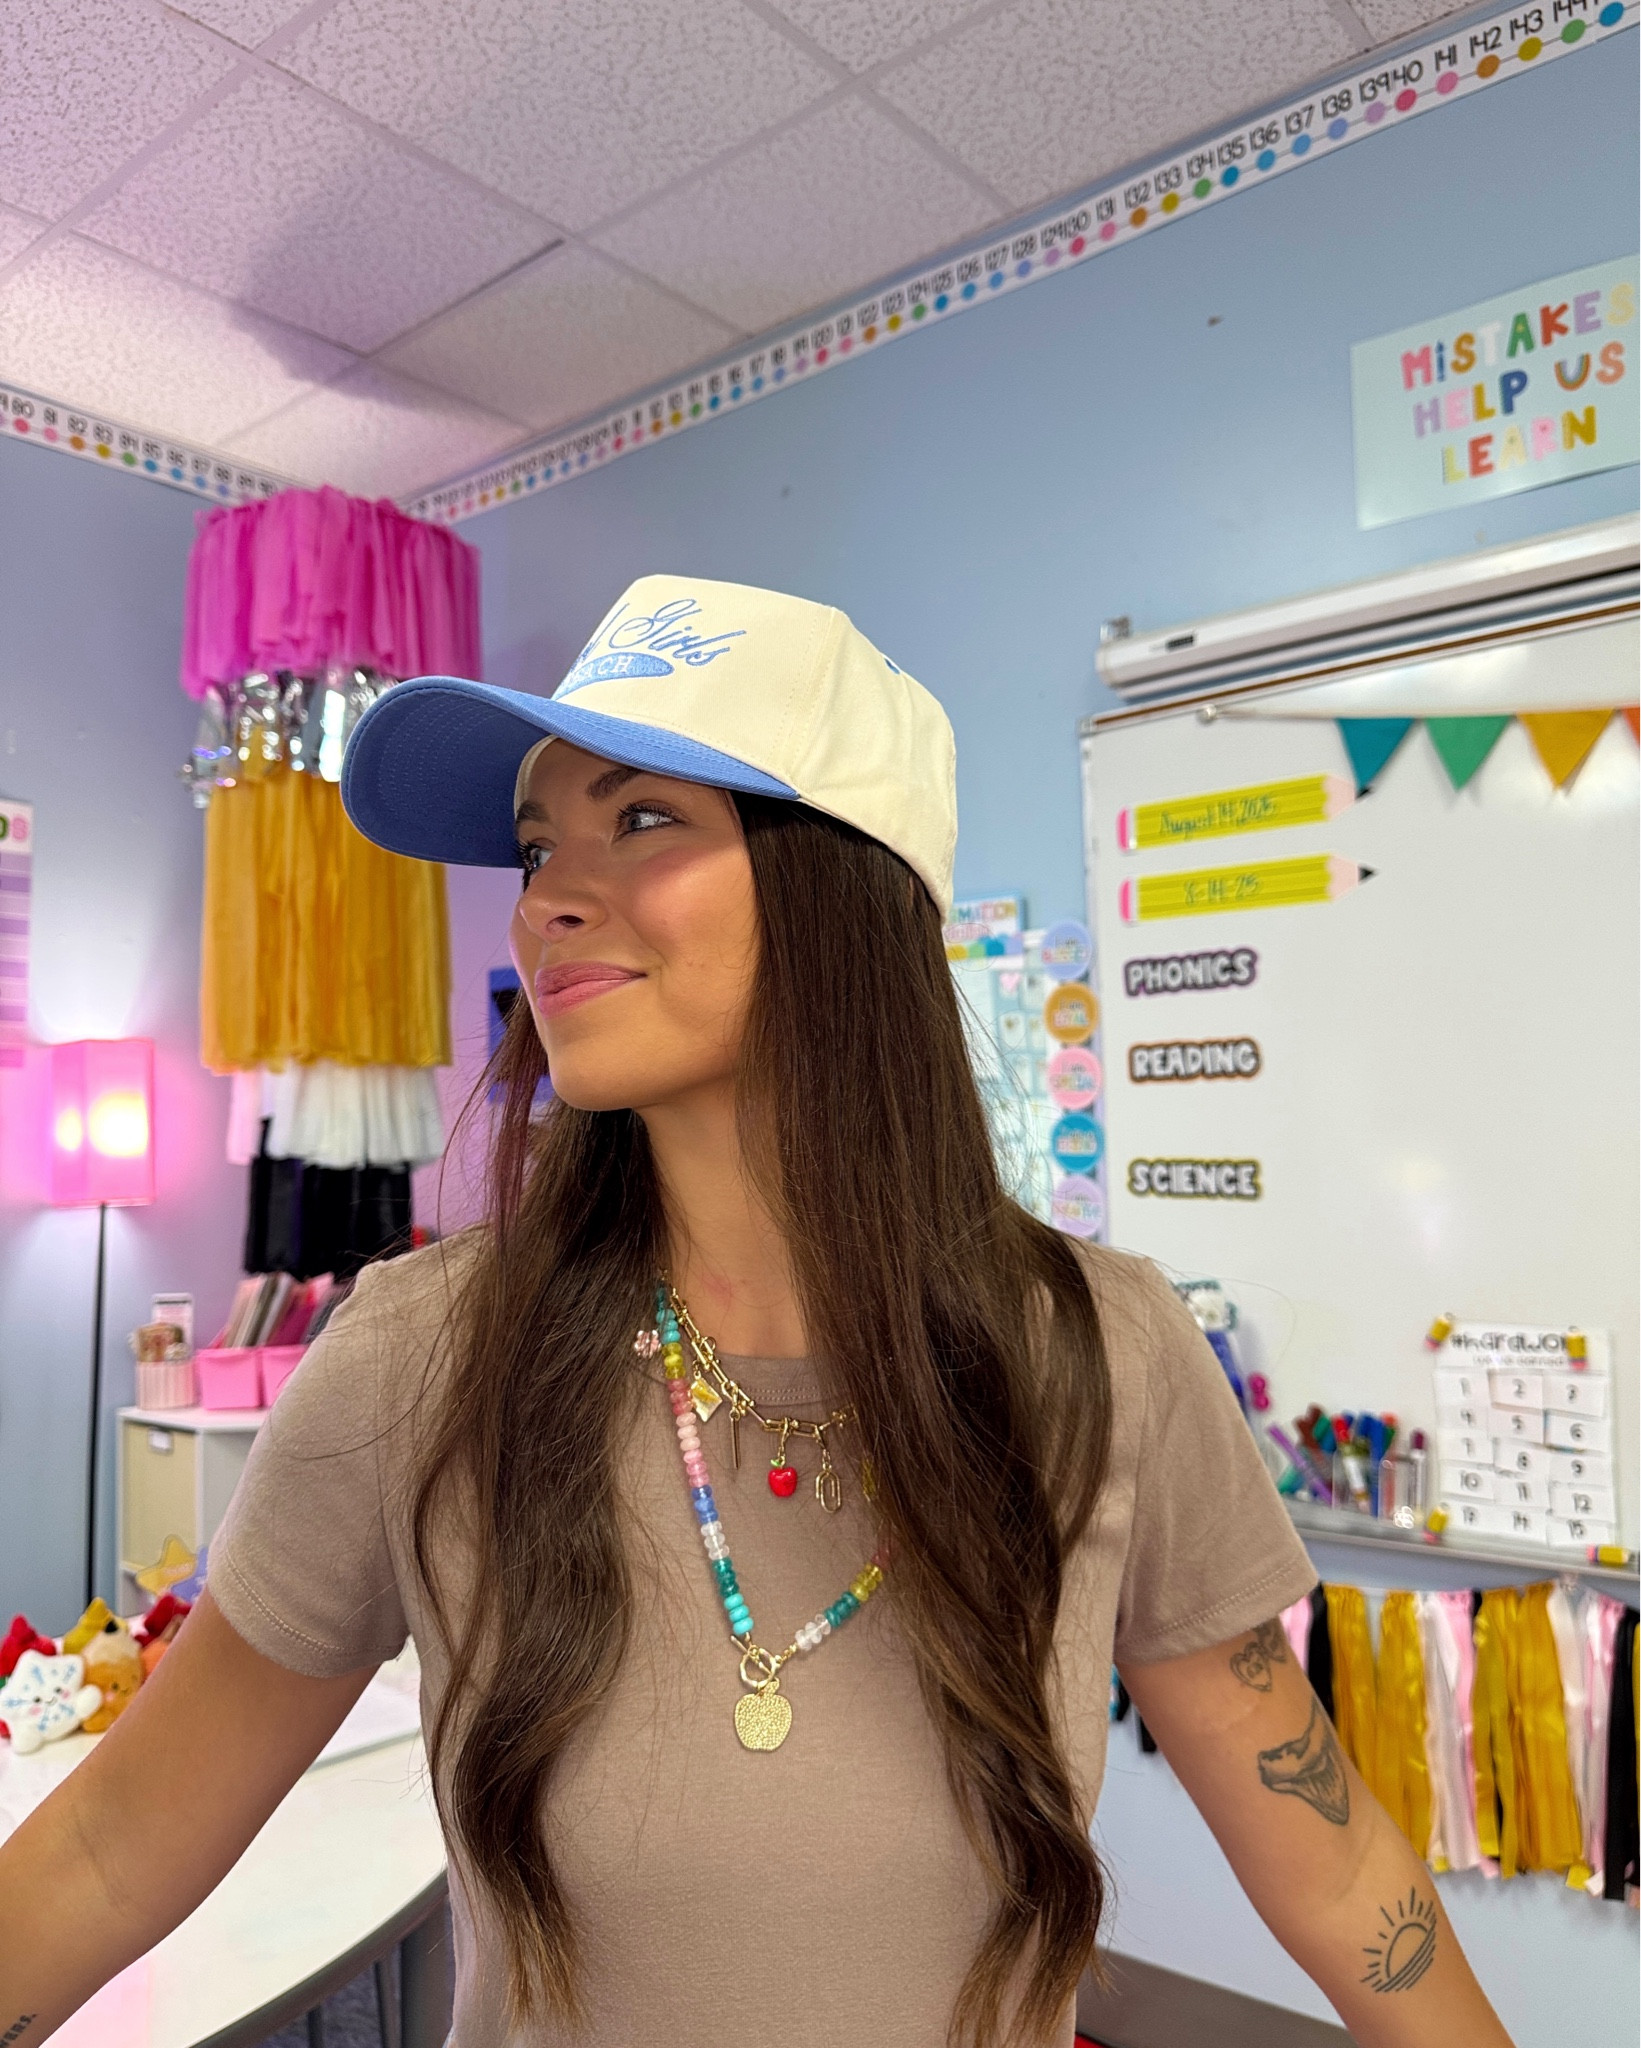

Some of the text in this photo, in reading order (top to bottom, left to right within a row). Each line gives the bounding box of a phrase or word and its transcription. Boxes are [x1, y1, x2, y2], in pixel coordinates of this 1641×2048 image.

[1096, 196, 1115, 221] 131
[1124, 180, 1150, 208] 132
[1155, 165, 1182, 194] 133
[1187, 149, 1216, 178] 134
[1217, 135, 1247, 165] 135
[1250, 120, 1280, 150] 136
[1285, 104, 1315, 136] 137
[1322, 89, 1353, 119] 138
[1359, 70, 1389, 103] 139
[1435, 44, 1457, 72] 141
[1470, 26, 1502, 57] 142
[1510, 9, 1544, 40] 143
[1413, 341, 1626, 440] HELP US
[12, 397, 35, 419] 80
[67, 414, 88, 435] 82
[1441, 405, 1598, 485] LEARN
[608, 598, 748, 667] Girls
[1160, 806, 1215, 840] August
[1127, 952, 1253, 993] PHONICS
[1132, 1043, 1259, 1079] READING
[1131, 1161, 1257, 1198] SCIENCE
[1513, 1379, 1526, 1398] 2
[1570, 1423, 1585, 1441] 6
[1460, 1471, 1483, 1490] 10
[1574, 1493, 1592, 1513] 12
[1568, 1520, 1586, 1539] 15
